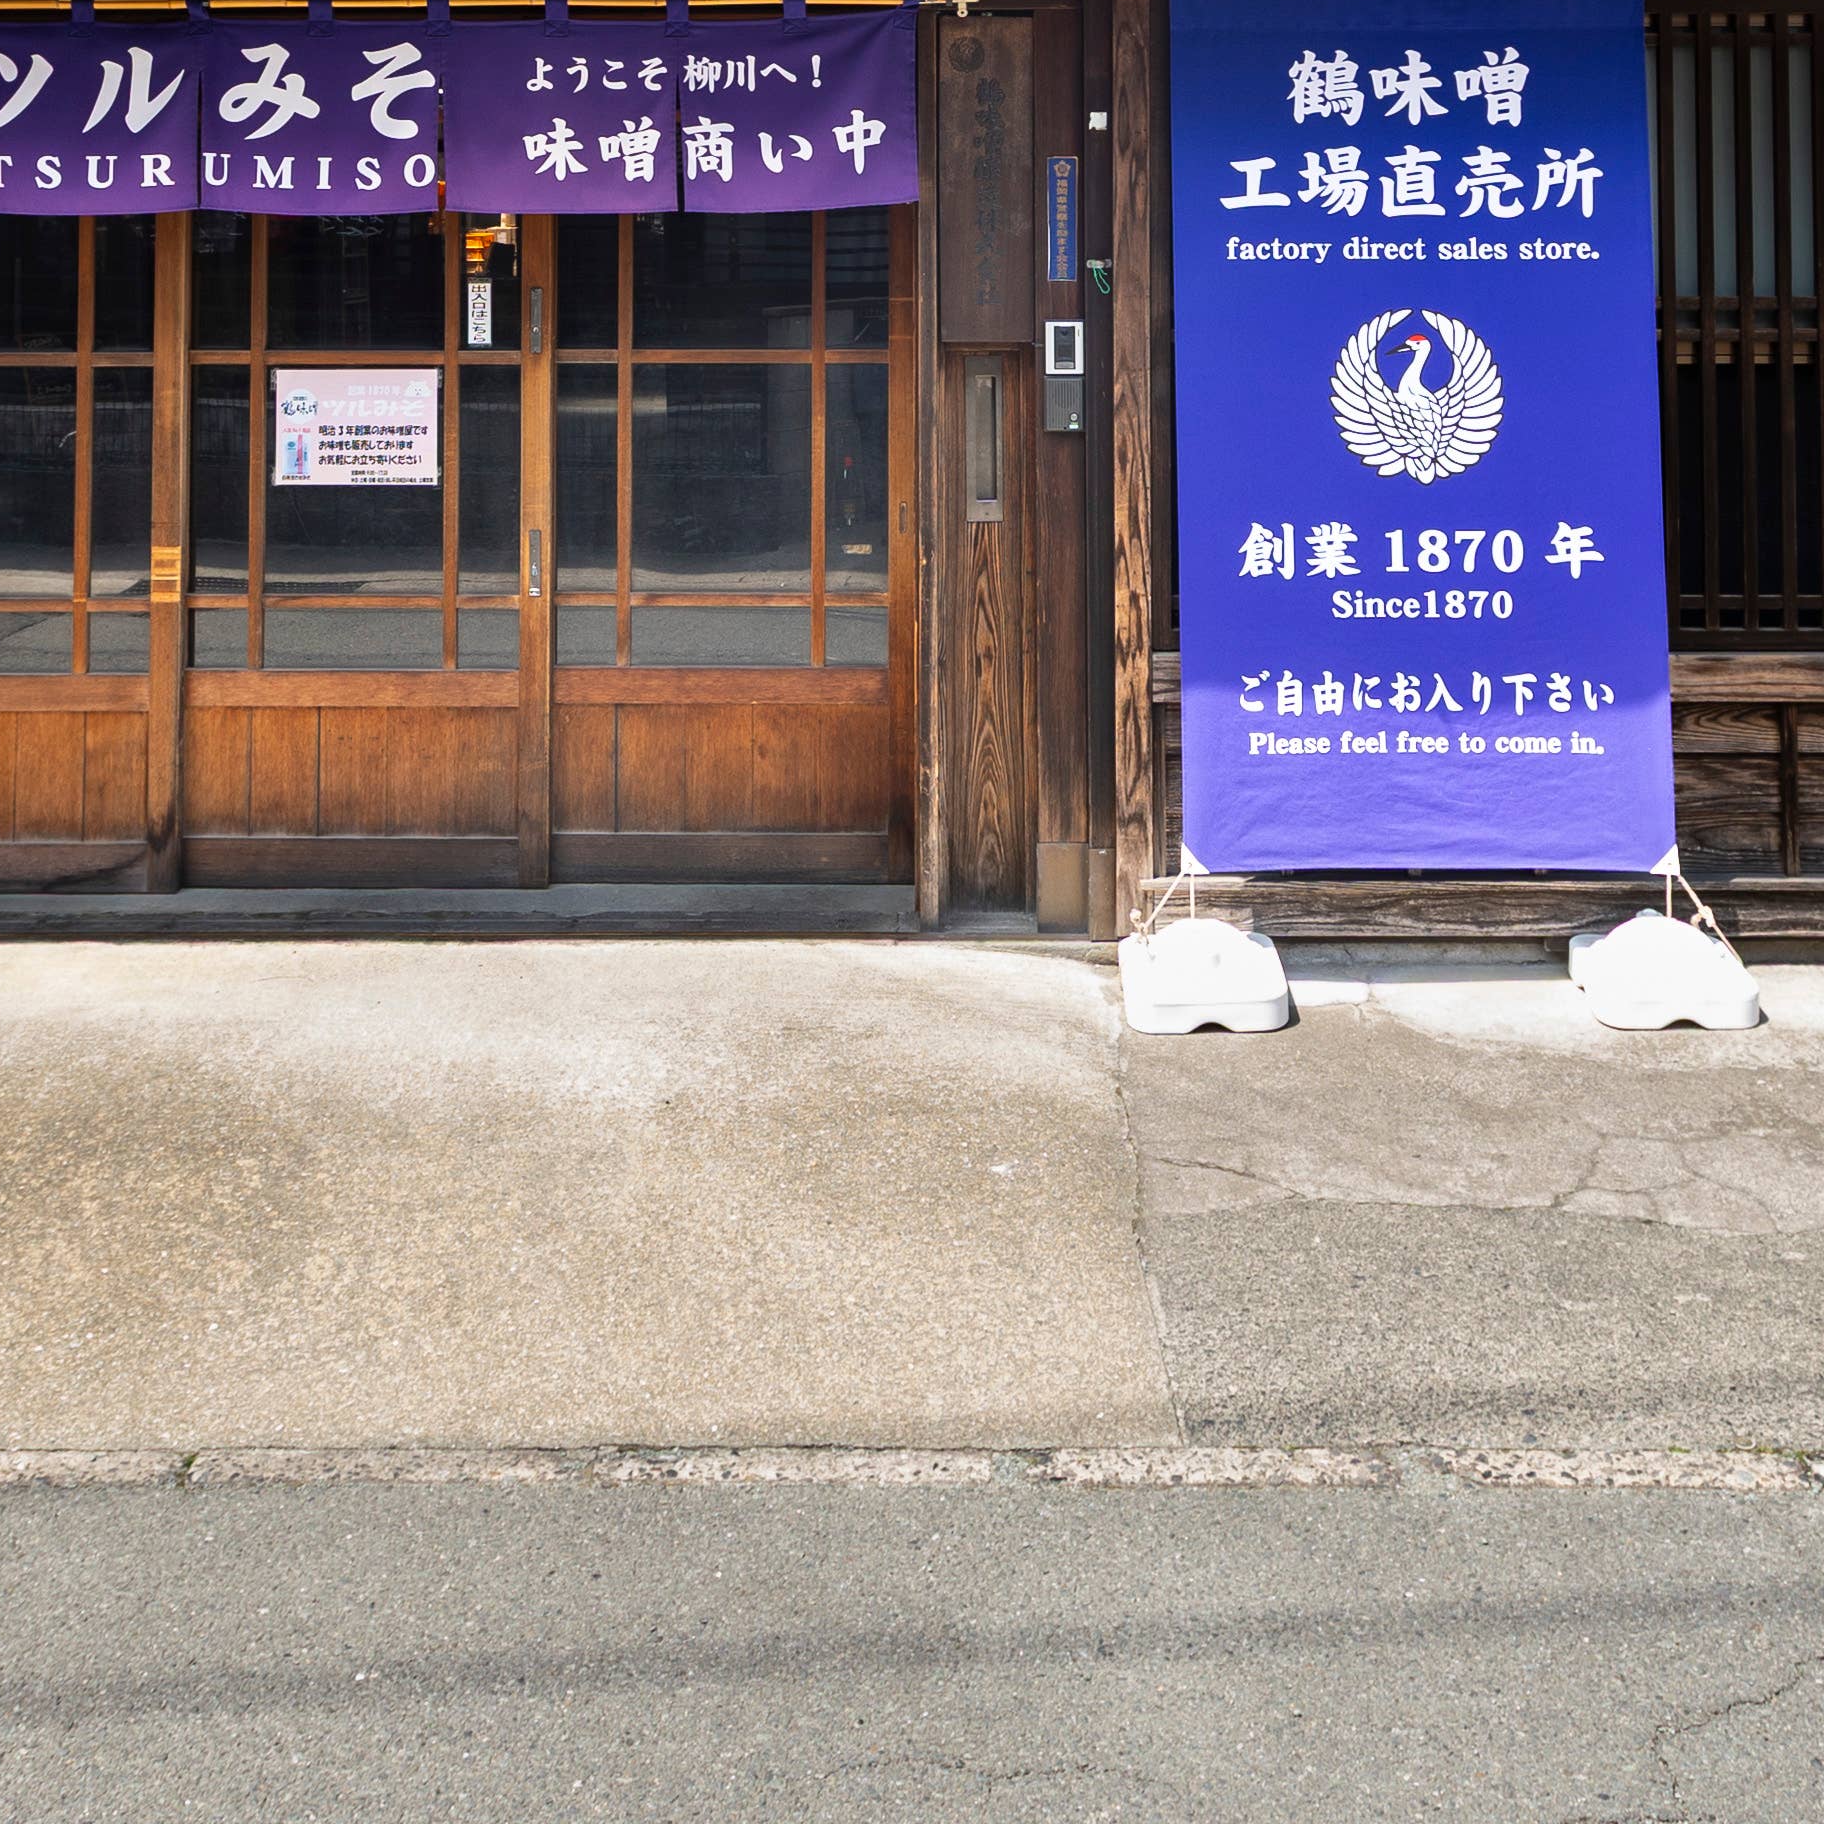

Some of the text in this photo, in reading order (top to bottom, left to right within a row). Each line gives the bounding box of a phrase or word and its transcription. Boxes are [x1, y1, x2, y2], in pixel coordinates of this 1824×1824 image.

[1286, 46, 1530, 127] 鶴味噌
[522, 109, 888, 183] 味噌商い中
[1219, 145, 1604, 219] 工場直売所
[1226, 236, 1600, 264] factory direct sales store.
[471, 284, 488, 343] 出入口はこちら
[322, 399, 425, 417] ツルみそ
[1331, 590, 1513, 619] Since1870
[1239, 670, 1615, 717] ご自由にお入り下さい
[1248, 730, 1605, 755] Please feel free to come in.
